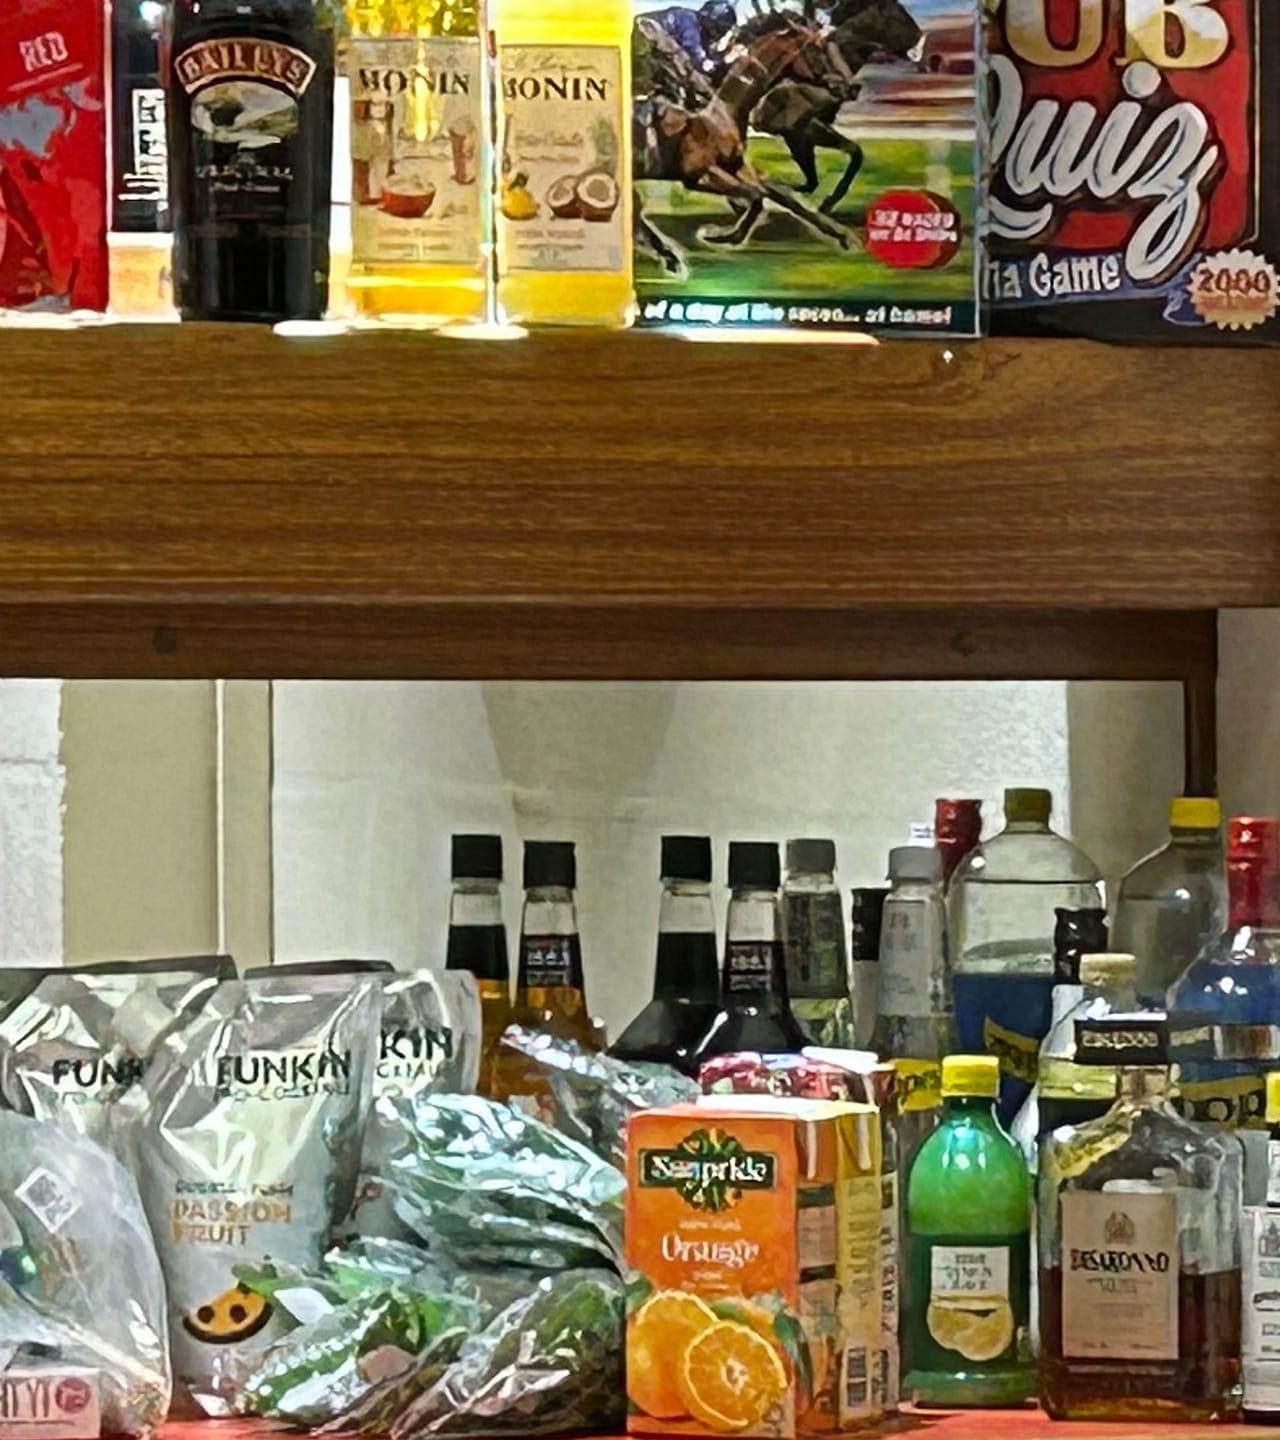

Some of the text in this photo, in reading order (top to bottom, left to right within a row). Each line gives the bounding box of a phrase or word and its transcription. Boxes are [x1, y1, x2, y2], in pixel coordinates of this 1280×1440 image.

[18, 31, 69, 72] RED
[358, 68, 471, 96] MONIN
[1029, 252, 1122, 297] Game
[172, 1199, 291, 1224] PASSION
[661, 1232, 760, 1268] Orange
